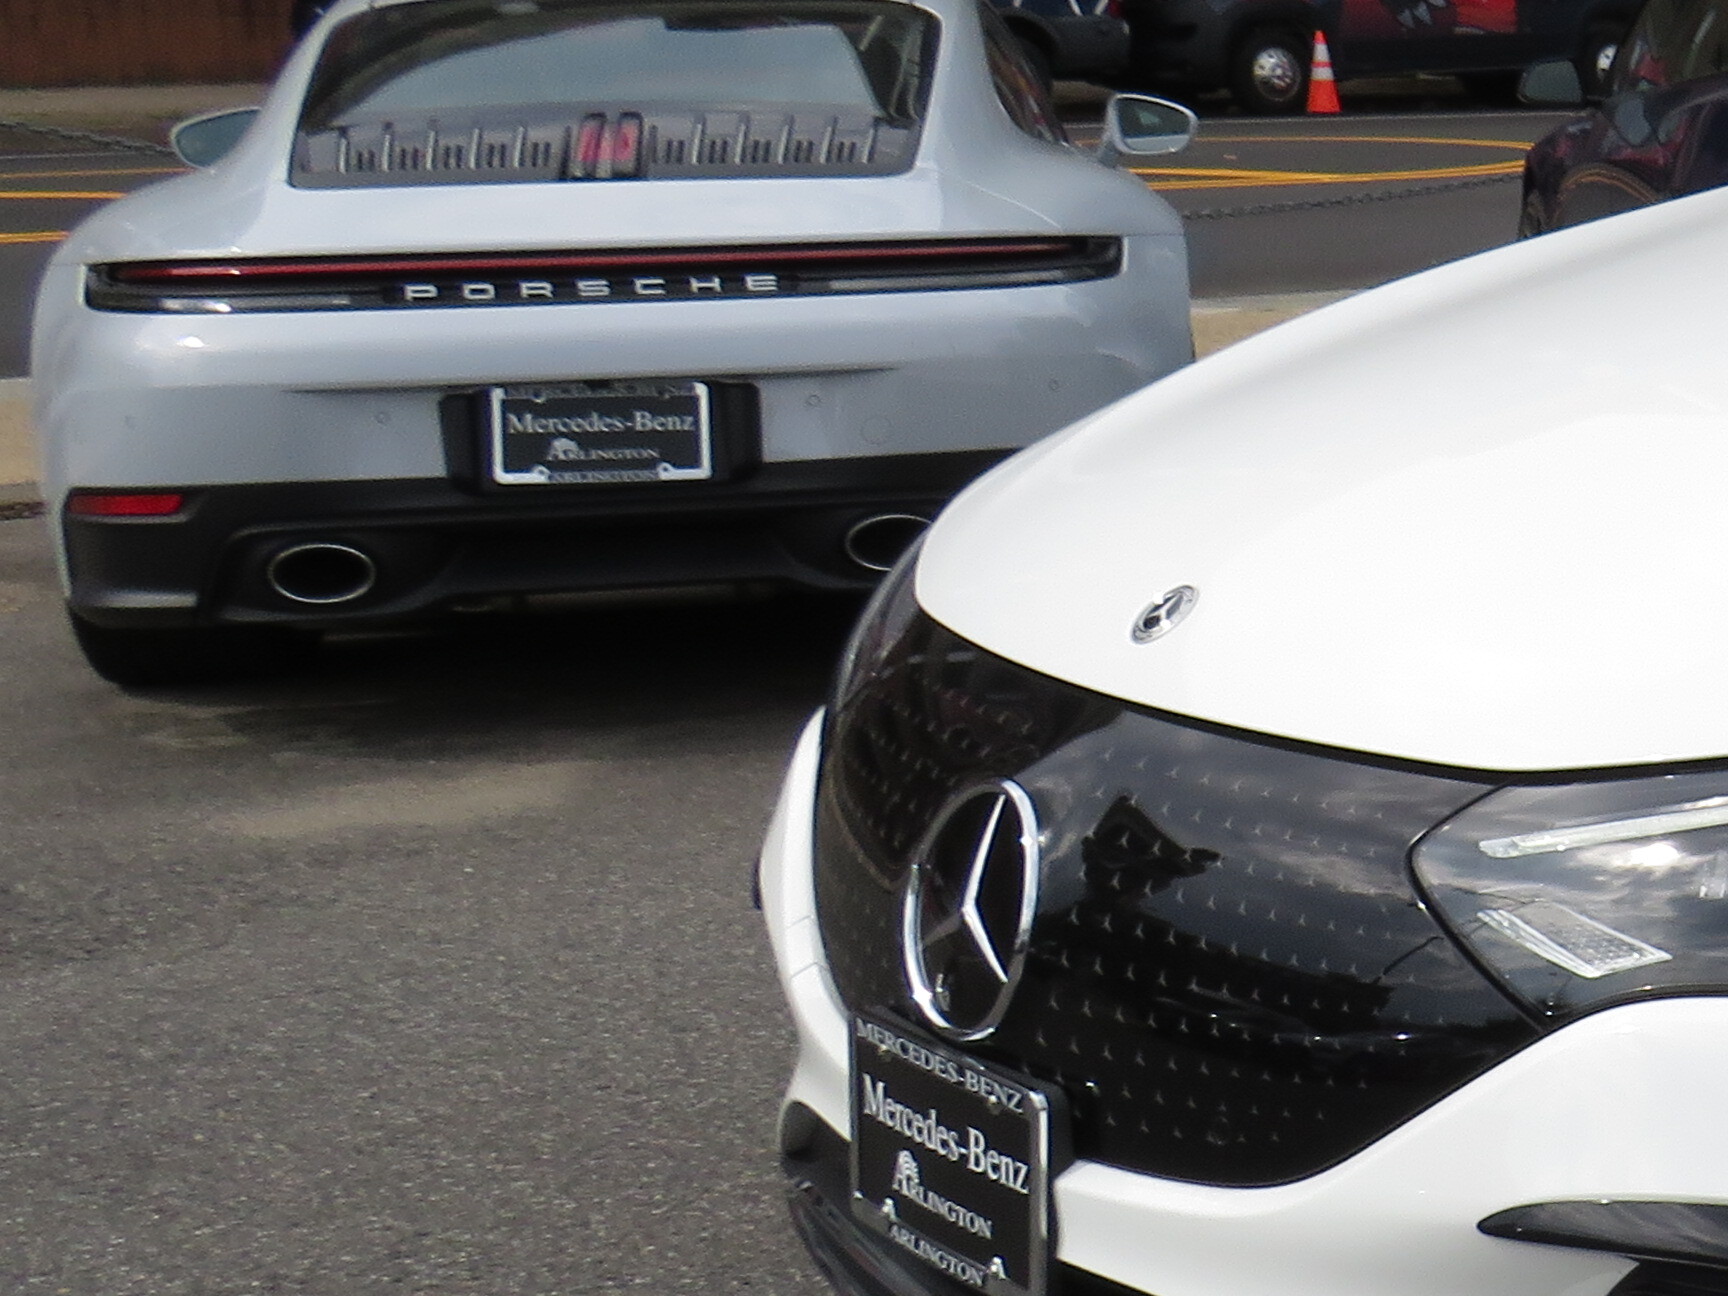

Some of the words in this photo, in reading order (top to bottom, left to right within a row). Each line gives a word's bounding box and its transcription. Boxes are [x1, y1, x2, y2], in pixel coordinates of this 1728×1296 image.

[403, 274, 779, 302] PORSCHE
[506, 410, 695, 435] Mercedes-Benz
[857, 1016, 1025, 1114] MERCEDES-BENZ
[861, 1071, 1030, 1195] Mercedes-Benz
[891, 1162, 993, 1240] ARLINGTON
[889, 1223, 984, 1288] ARLINGTON
